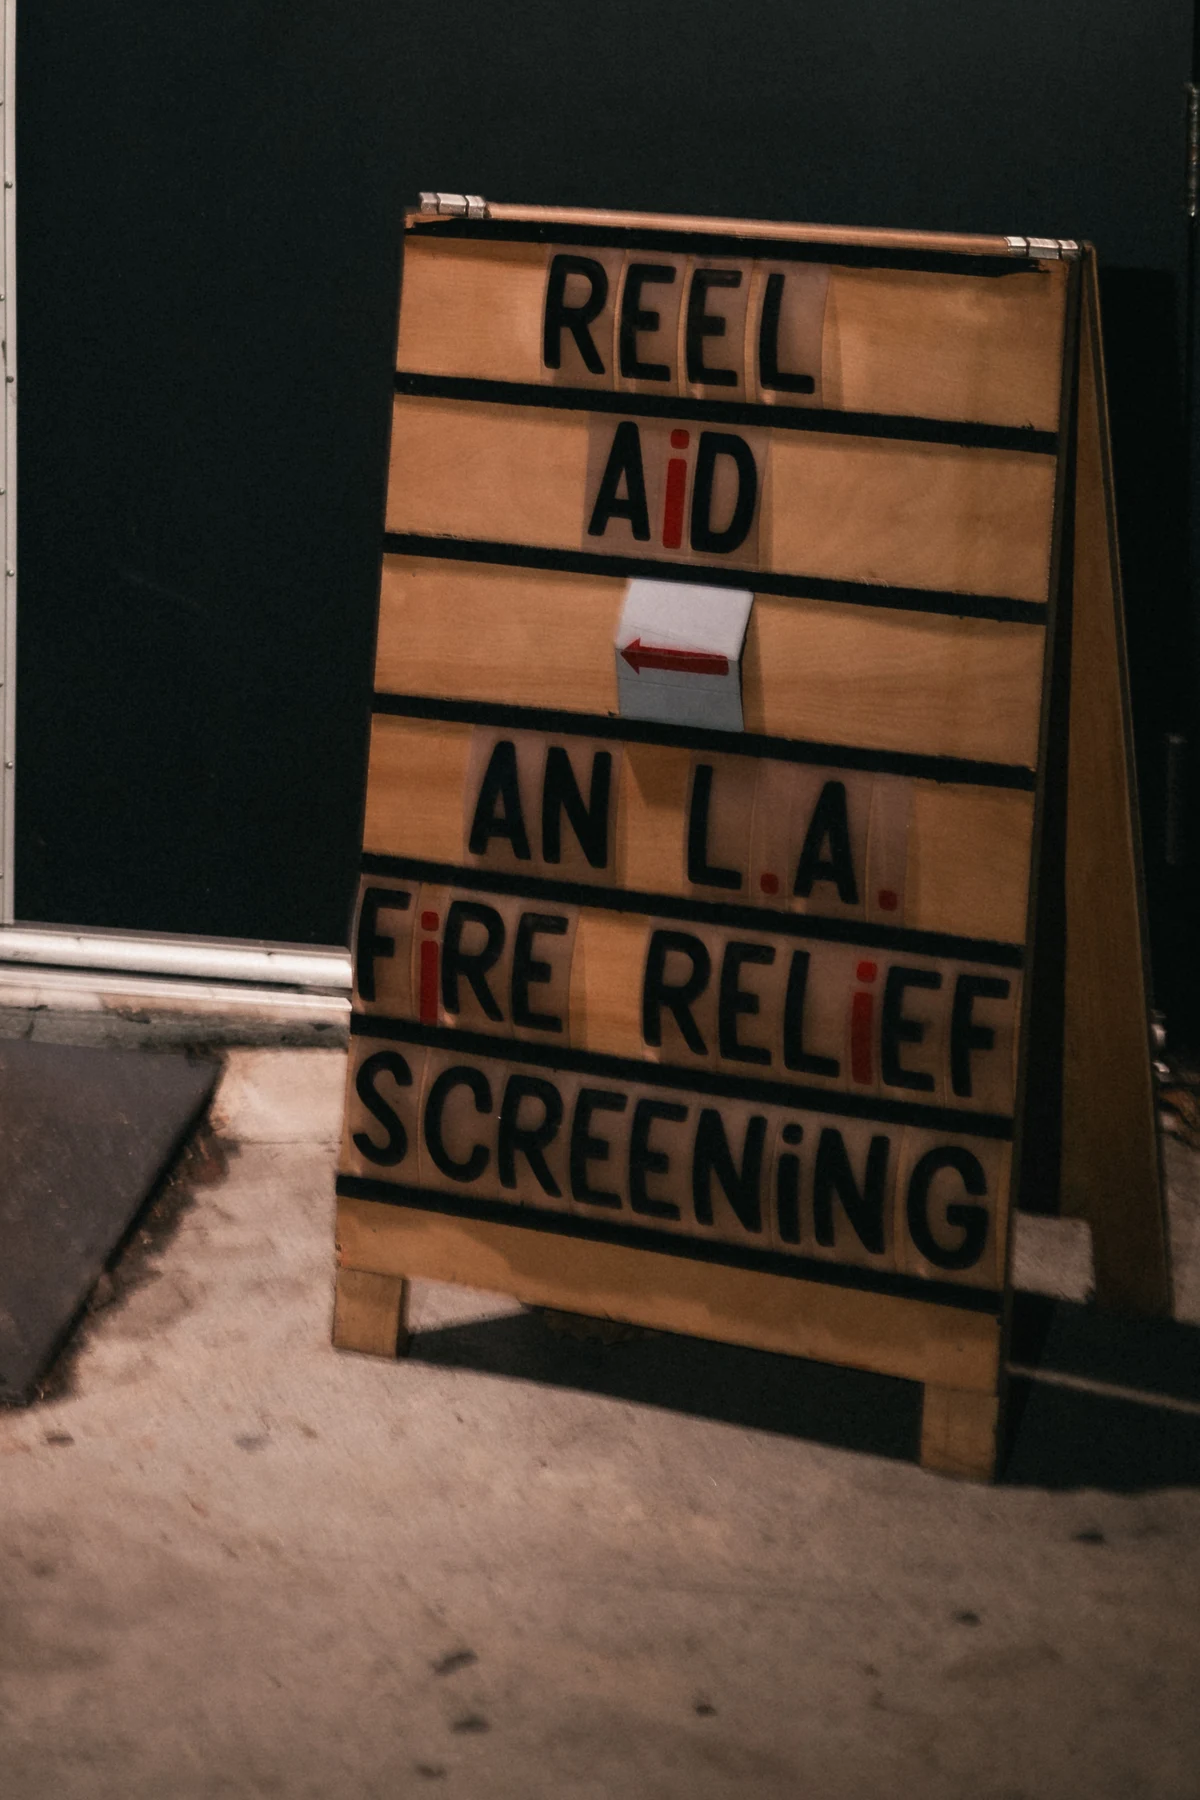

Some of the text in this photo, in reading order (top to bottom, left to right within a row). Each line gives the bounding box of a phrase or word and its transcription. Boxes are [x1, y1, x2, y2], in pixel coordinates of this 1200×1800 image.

[543, 254, 815, 394] REEL
[468, 741, 897, 911] AN L.A.
